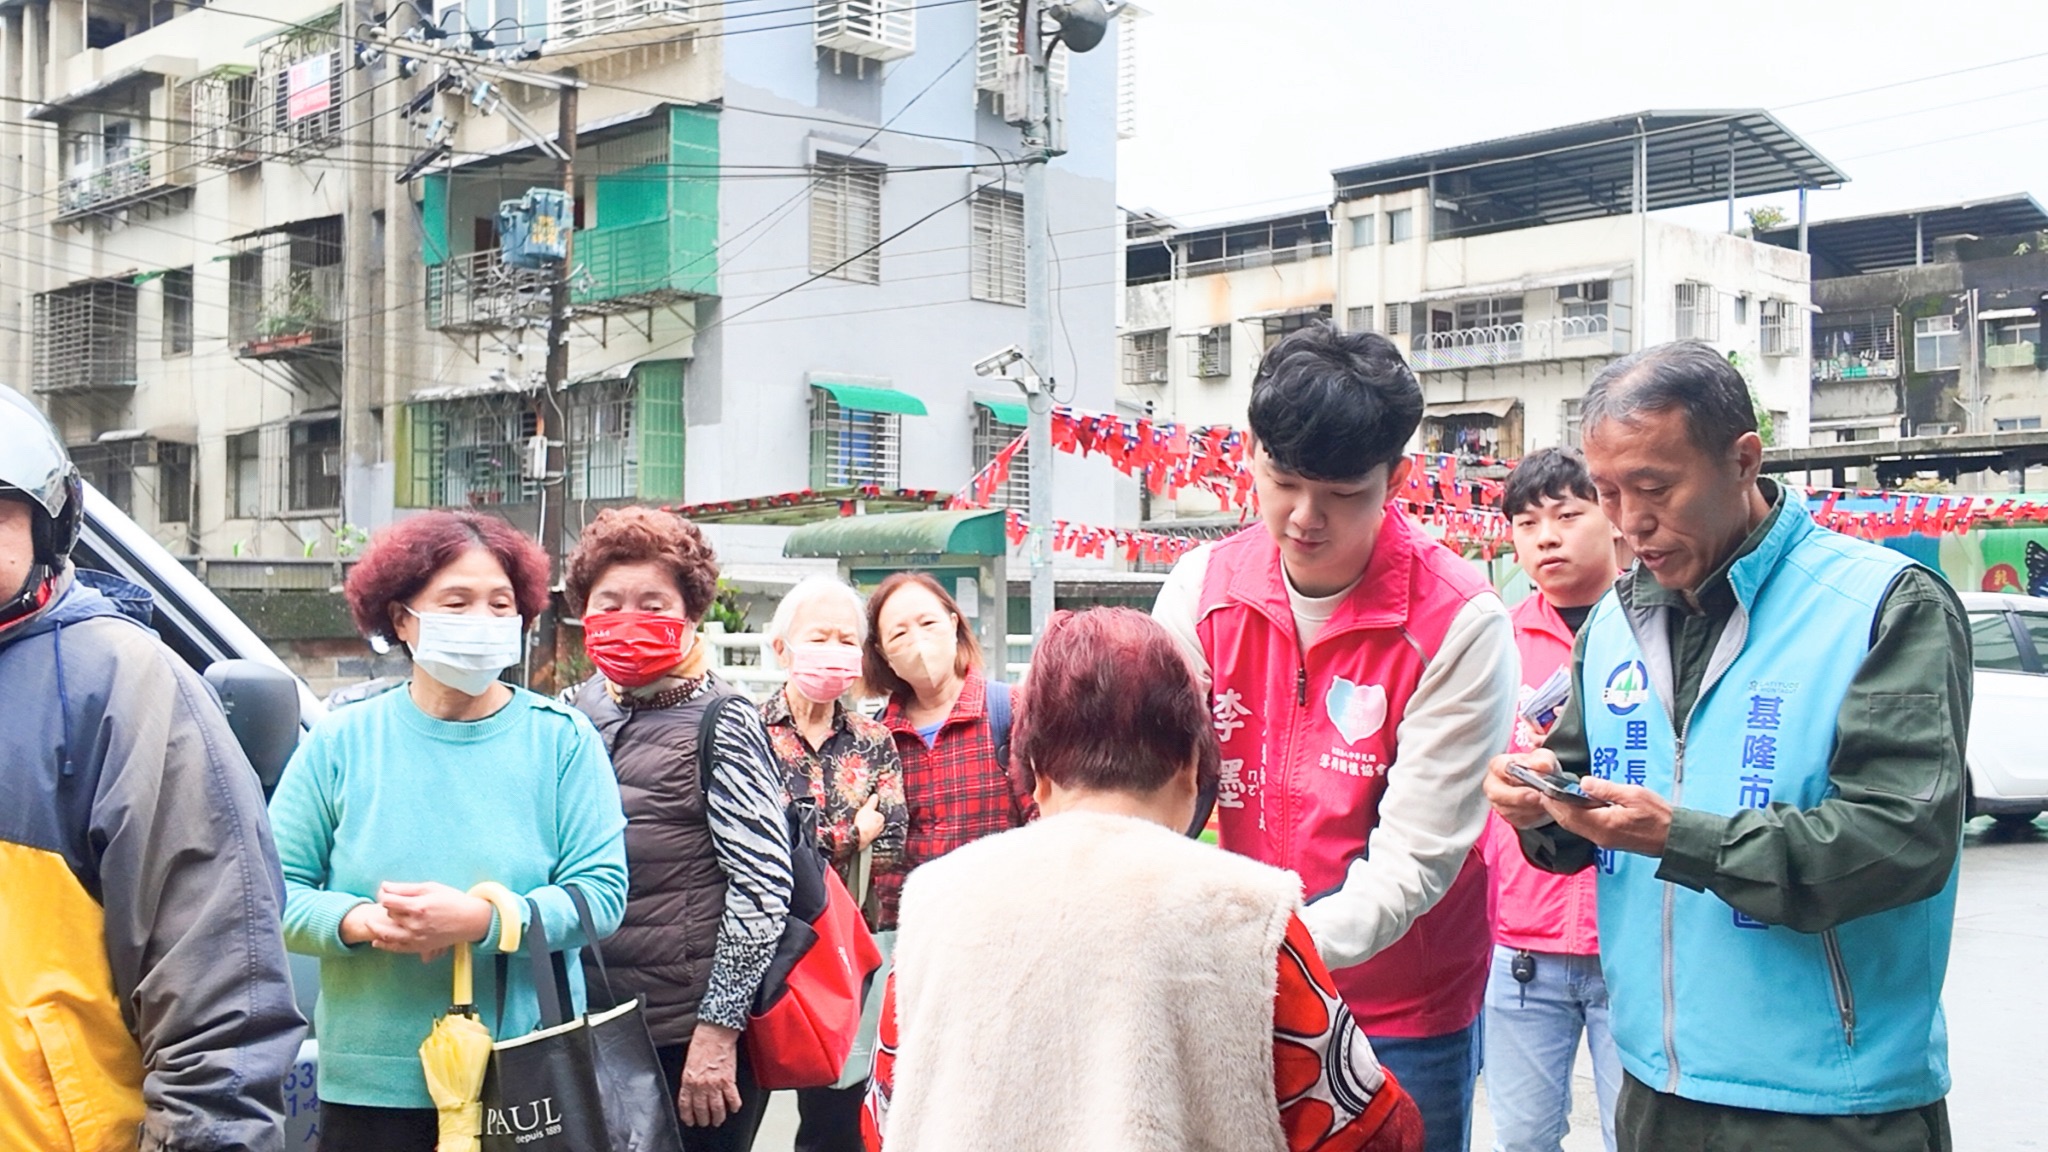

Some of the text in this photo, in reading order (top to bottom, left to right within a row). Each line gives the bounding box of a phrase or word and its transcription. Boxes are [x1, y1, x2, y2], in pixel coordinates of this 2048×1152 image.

[1624, 720, 1648, 787] 里長
[486, 1096, 563, 1136] PAUL
[514, 1129, 545, 1144] depuis
